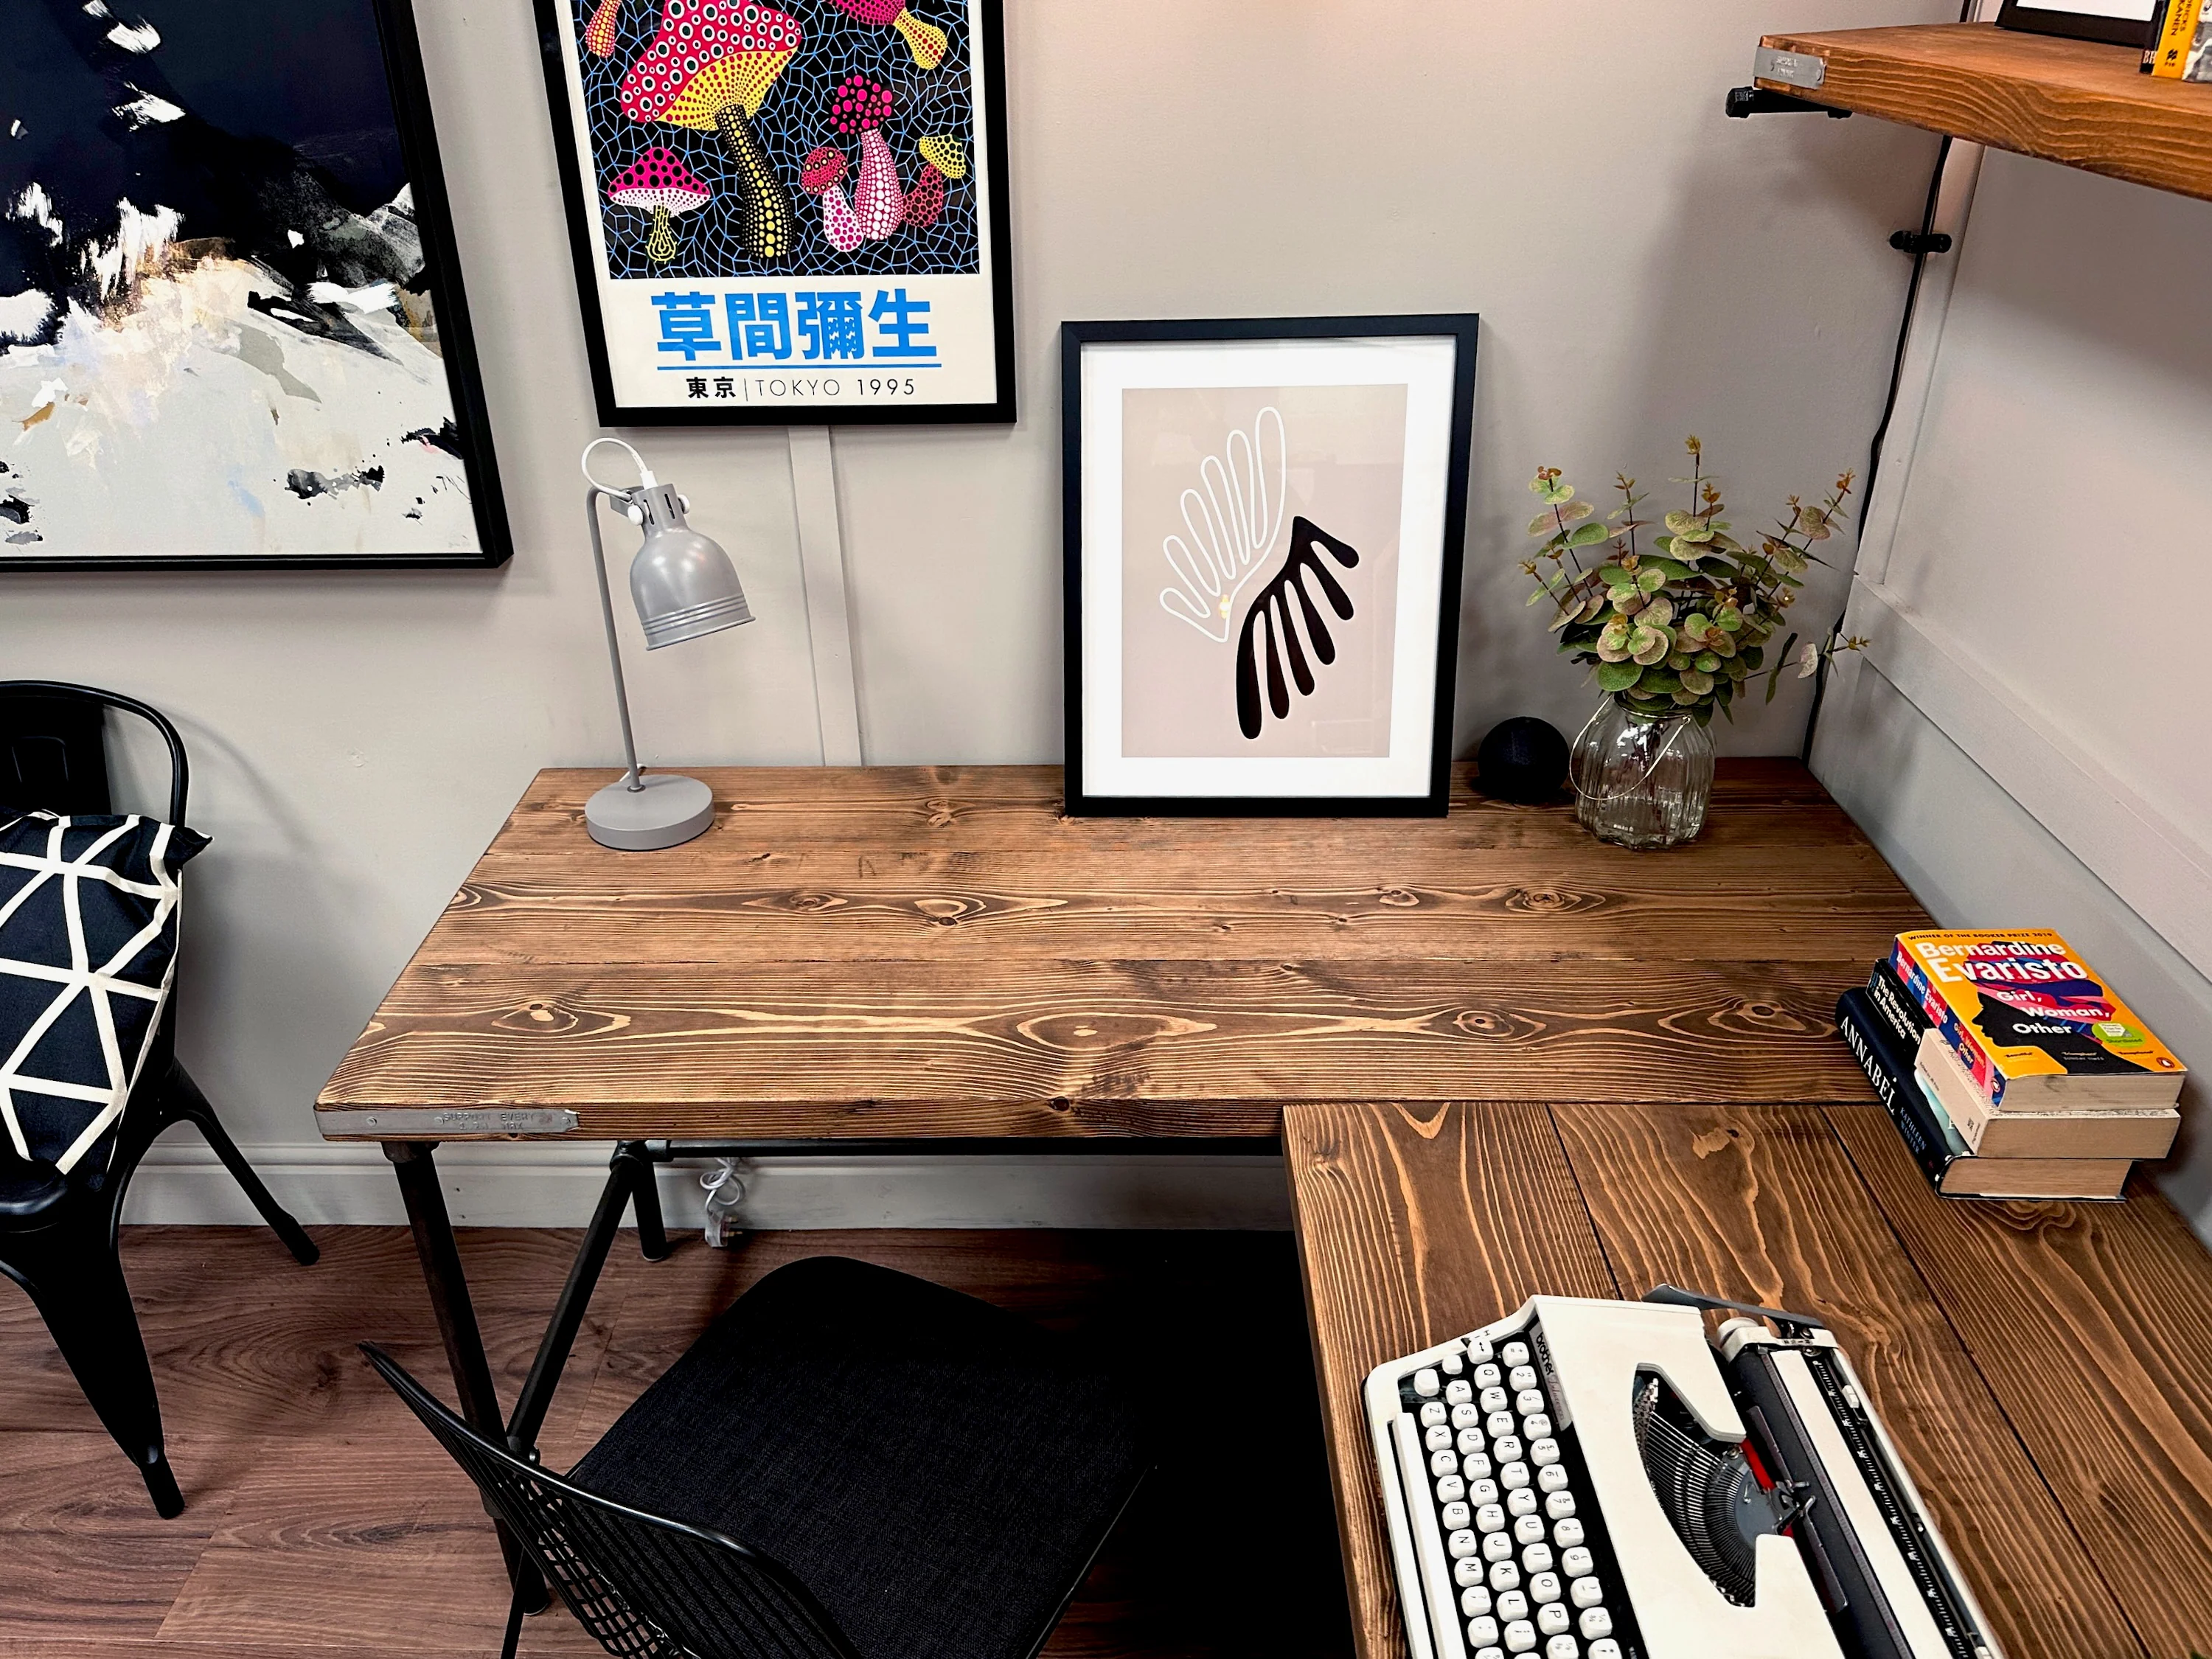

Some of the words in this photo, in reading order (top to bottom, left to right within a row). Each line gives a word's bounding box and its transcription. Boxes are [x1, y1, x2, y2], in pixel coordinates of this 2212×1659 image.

[651, 288, 937, 361] 草間彌生
[686, 376, 737, 399] 東京
[755, 379, 841, 397] TOKYO
[858, 378, 915, 395] 1995
[1915, 941, 2066, 959] Bernardine
[1927, 957, 2088, 983] Evaristo
[1897, 951, 1926, 994] Bernardine
[1924, 989, 1948, 1023] Evaristo
[1997, 990, 2042, 1002] Girl,
[1874, 987, 1880, 1001] in
[1879, 998, 1906, 1039] America
[1877, 975, 1889, 996] The
[1888, 992, 1921, 1045] Revolution
[2012, 1023, 2072, 1034] Other
[2020, 1006, 2110, 1018] Woman,
[1840, 1016, 1896, 1115] ANNABEL
[1899, 1107, 1927, 1150] KATHLEEN
[1536, 1332, 1554, 1376] brother
